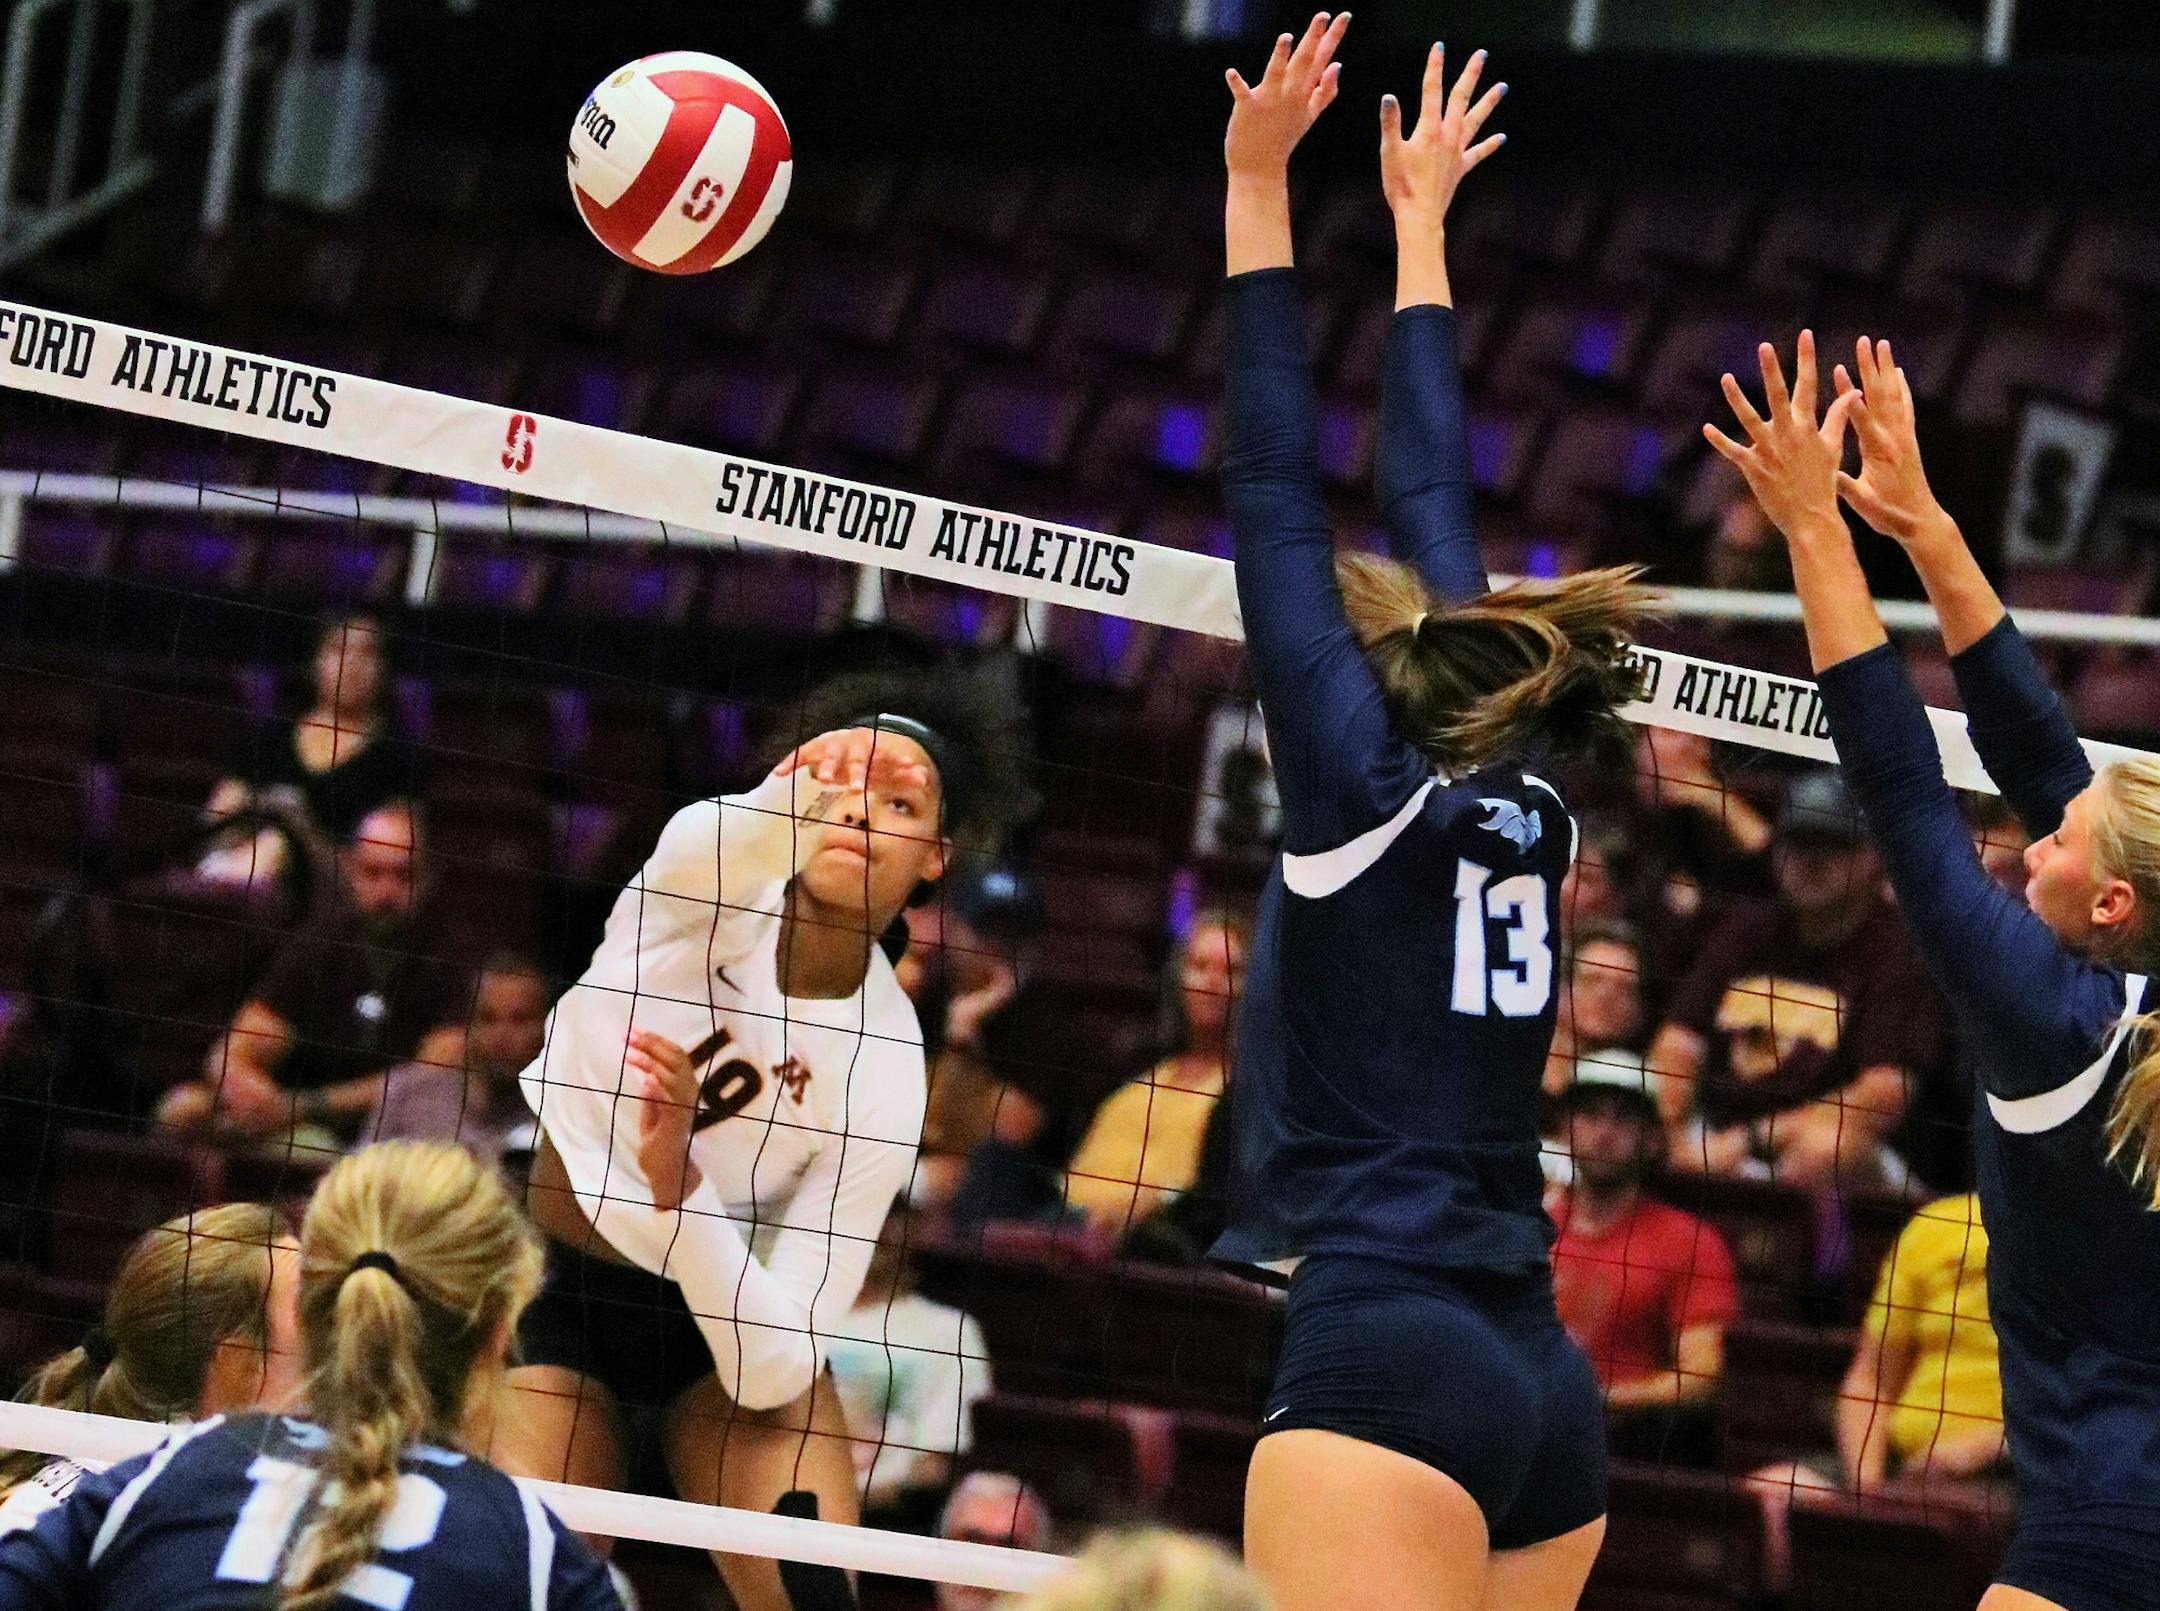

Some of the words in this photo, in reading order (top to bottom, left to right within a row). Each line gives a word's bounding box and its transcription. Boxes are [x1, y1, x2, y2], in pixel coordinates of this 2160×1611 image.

[111, 335, 337, 429] ATHLETICS
[715, 463, 917, 550] STANFORD
[929, 508, 1135, 597] ATHLETICS
[1673, 662, 1831, 740] ATHLETIC
[1450, 857, 1552, 1017] 13
[688, 1027, 762, 1132] 19
